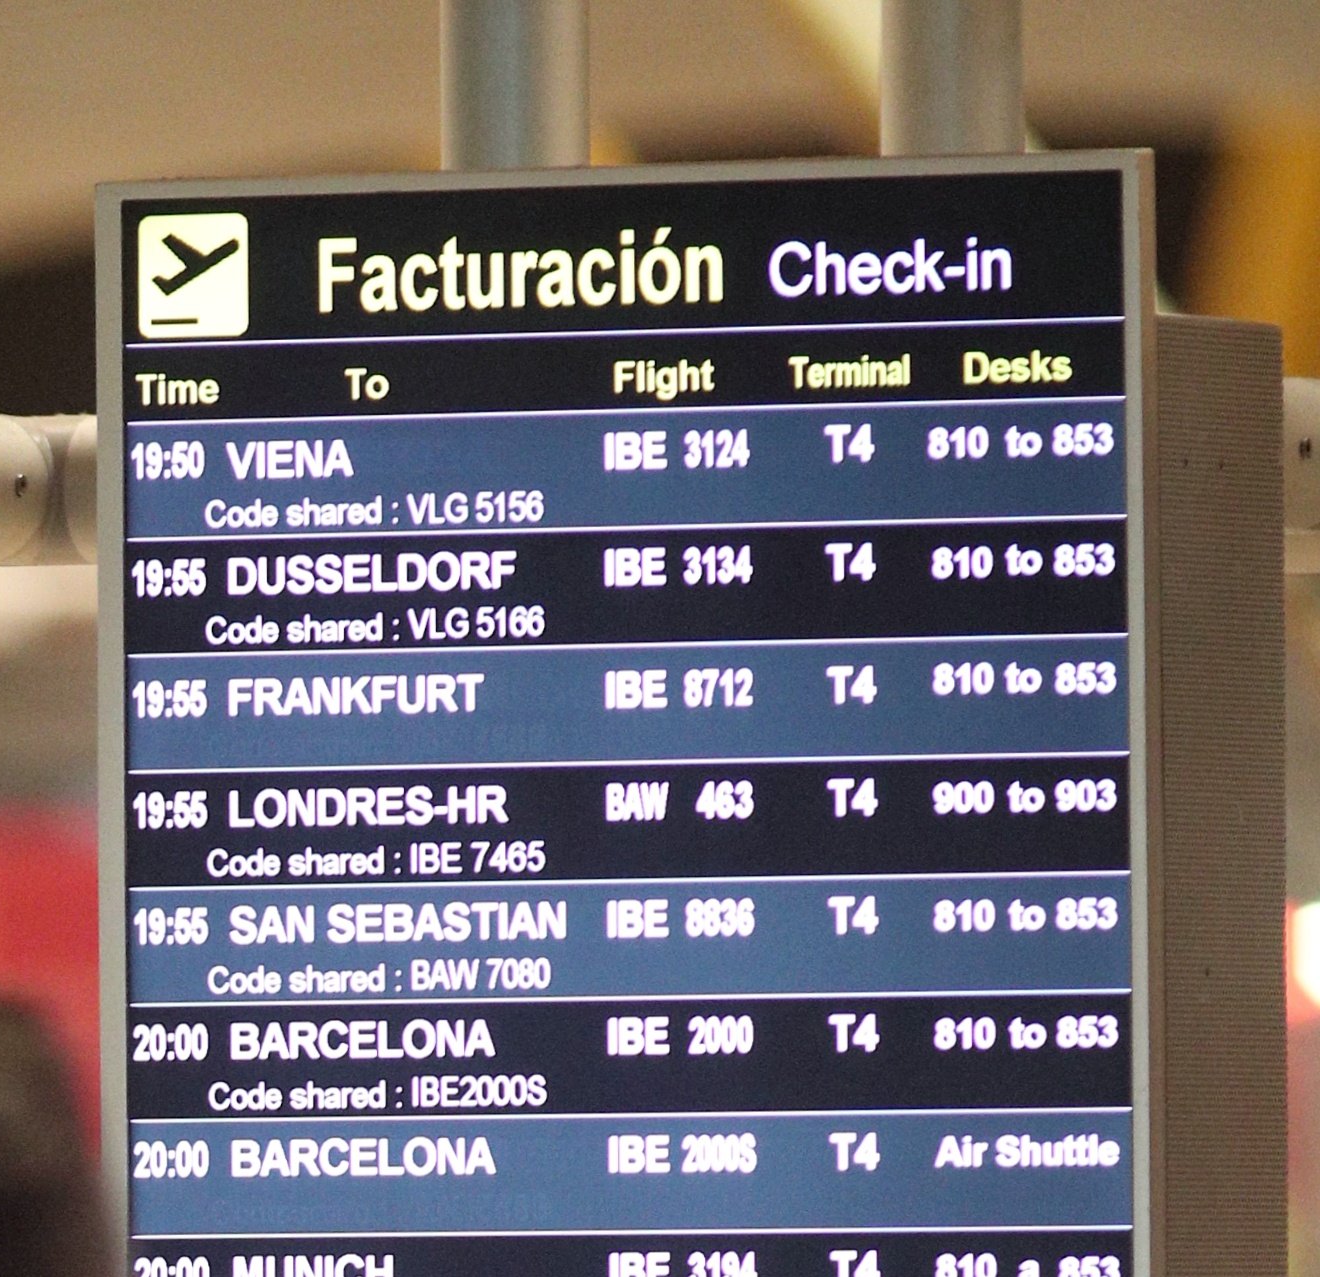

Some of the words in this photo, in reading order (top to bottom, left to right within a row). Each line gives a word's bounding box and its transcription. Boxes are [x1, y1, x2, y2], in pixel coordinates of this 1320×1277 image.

[317, 225, 725, 314] Facturación
[768, 235, 1013, 299] Check-in
[134, 372, 221, 407] Time
[343, 366, 391, 401] To
[613, 358, 716, 402] Flight
[787, 352, 912, 390] Terminal
[962, 348, 1074, 386] Desks
[130, 439, 206, 481] 19:50
[224, 438, 356, 481] VIENA
[603, 429, 669, 472] IBE
[683, 427, 752, 470] 3124
[822, 422, 876, 465] T4
[926, 424, 990, 461] 810
[1003, 424, 1044, 459] to
[1051, 421, 1116, 458] 853
[130, 557, 208, 598] 19:55
[226, 549, 518, 596] DUSSELDORF
[603, 546, 668, 588] IBE
[682, 544, 755, 586] 3134
[131, 678, 209, 720] 19:55
[227, 672, 486, 718] FRANKFURT
[604, 668, 669, 711] IBE
[682, 666, 755, 709] 8712
[132, 789, 209, 830] 19:55
[228, 784, 510, 829] LONDRES-HR
[605, 781, 671, 822] BAW
[694, 779, 755, 821] 463
[132, 905, 210, 947] 19:55
[228, 904, 316, 947] SAN
[325, 899, 568, 945] SEBASTIAN
[605, 897, 671, 940] IBE
[684, 896, 756, 939] 8836
[131, 1022, 210, 1063] 20:00
[229, 1018, 497, 1061] BARCELONA
[606, 1015, 671, 1057] IBE
[687, 1014, 755, 1056] 2000
[132, 1139, 211, 1180] 20:00
[230, 1135, 498, 1179] BARCELONA
[607, 1133, 672, 1175] IBE
[827, 1131, 882, 1173] T4
[933, 1134, 990, 1170] Air
[993, 1132, 1122, 1169] Shuttle
